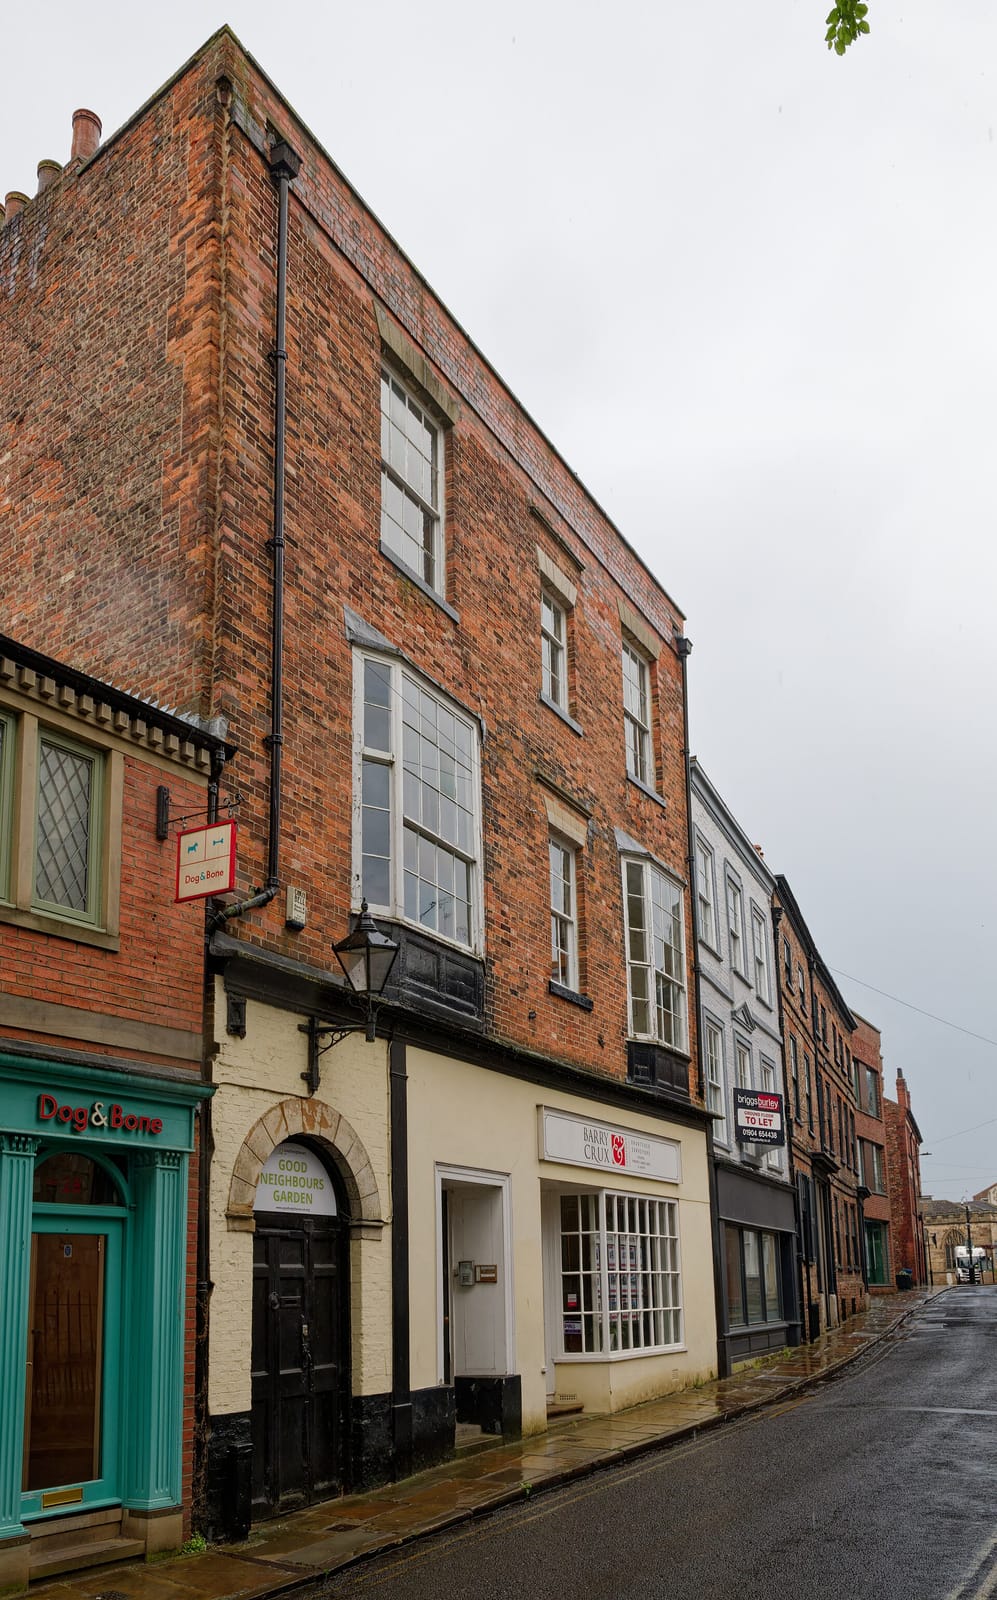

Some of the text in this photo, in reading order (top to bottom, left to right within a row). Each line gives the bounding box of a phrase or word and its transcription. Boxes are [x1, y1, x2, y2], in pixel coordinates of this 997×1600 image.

[745, 1116, 773, 1127] TO LET
[583, 1127, 609, 1146] BARRY
[584, 1144, 610, 1163] CRUX
[278, 1159, 308, 1173] GOOD
[260, 1172, 325, 1190] NEIGHBOURS
[273, 1190, 313, 1205] GARDEN
